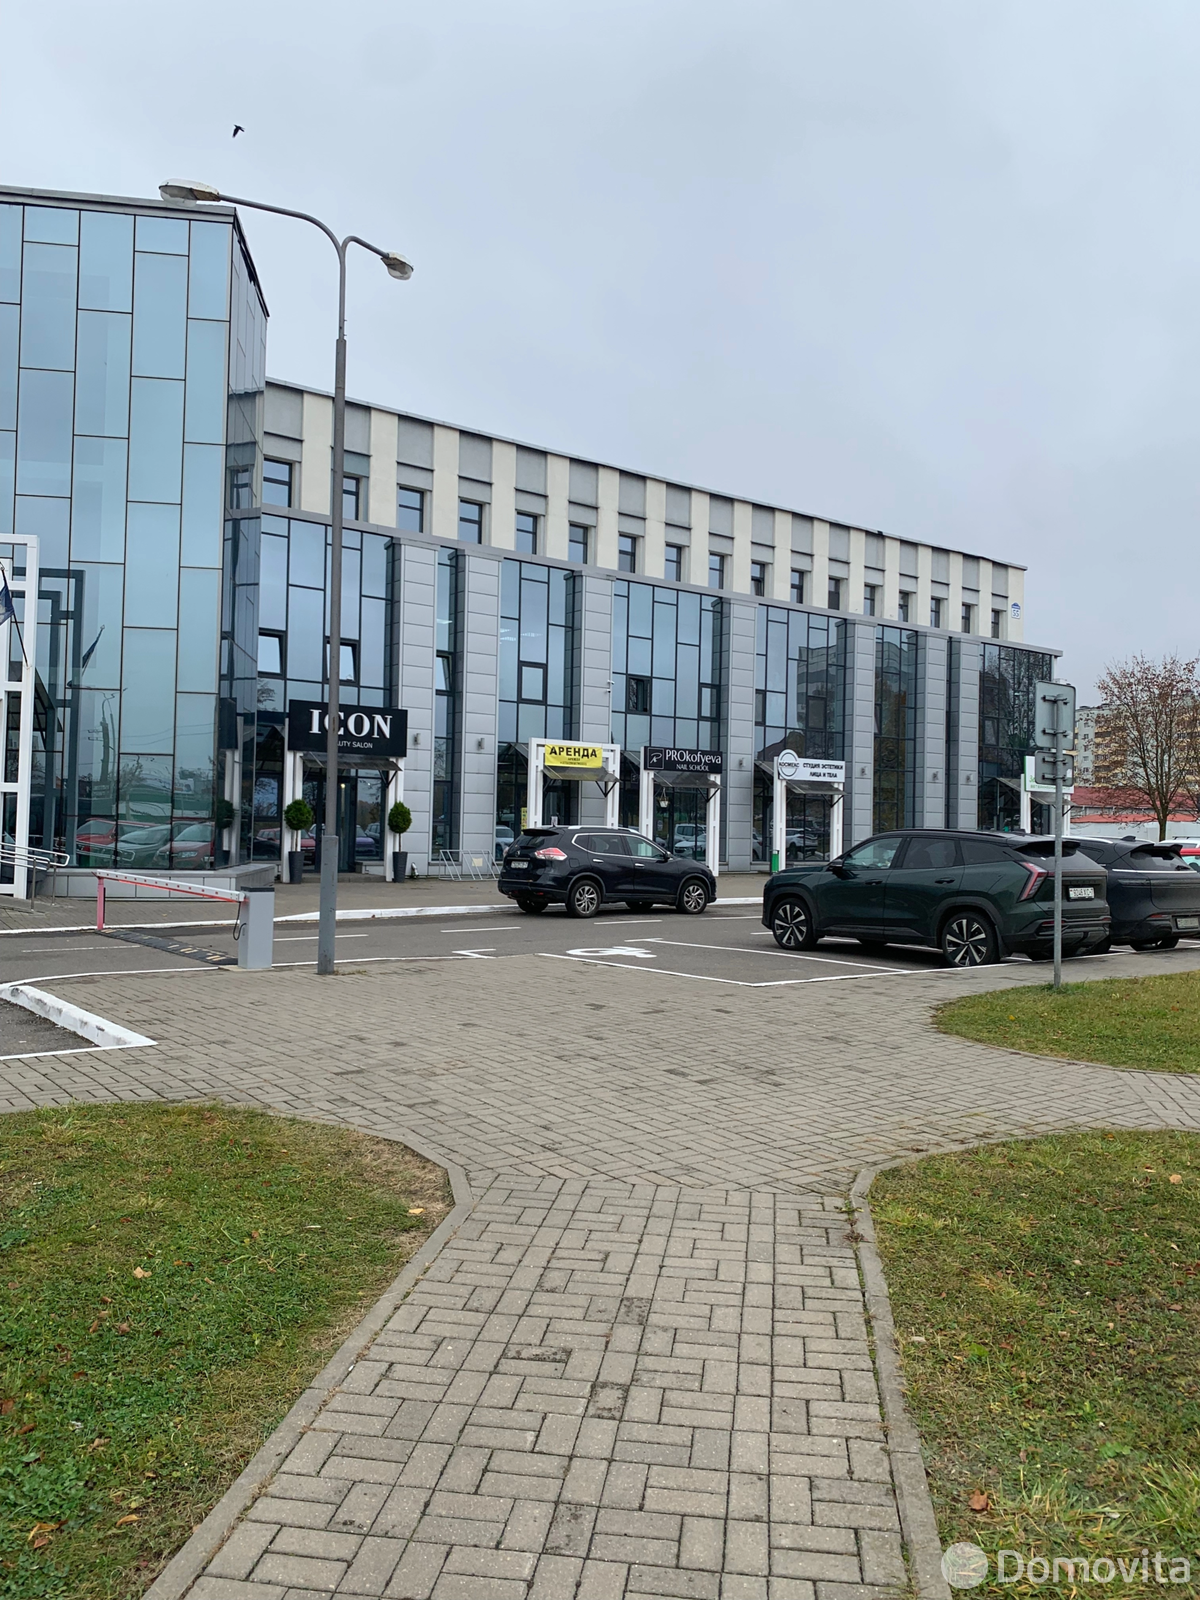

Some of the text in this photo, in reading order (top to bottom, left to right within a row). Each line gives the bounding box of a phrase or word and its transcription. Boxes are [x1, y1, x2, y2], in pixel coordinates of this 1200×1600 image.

[309, 708, 393, 739] ICON
[352, 741, 373, 749] SALON
[549, 746, 597, 759] АРЕНДА
[665, 749, 722, 766] PROkofyeva
